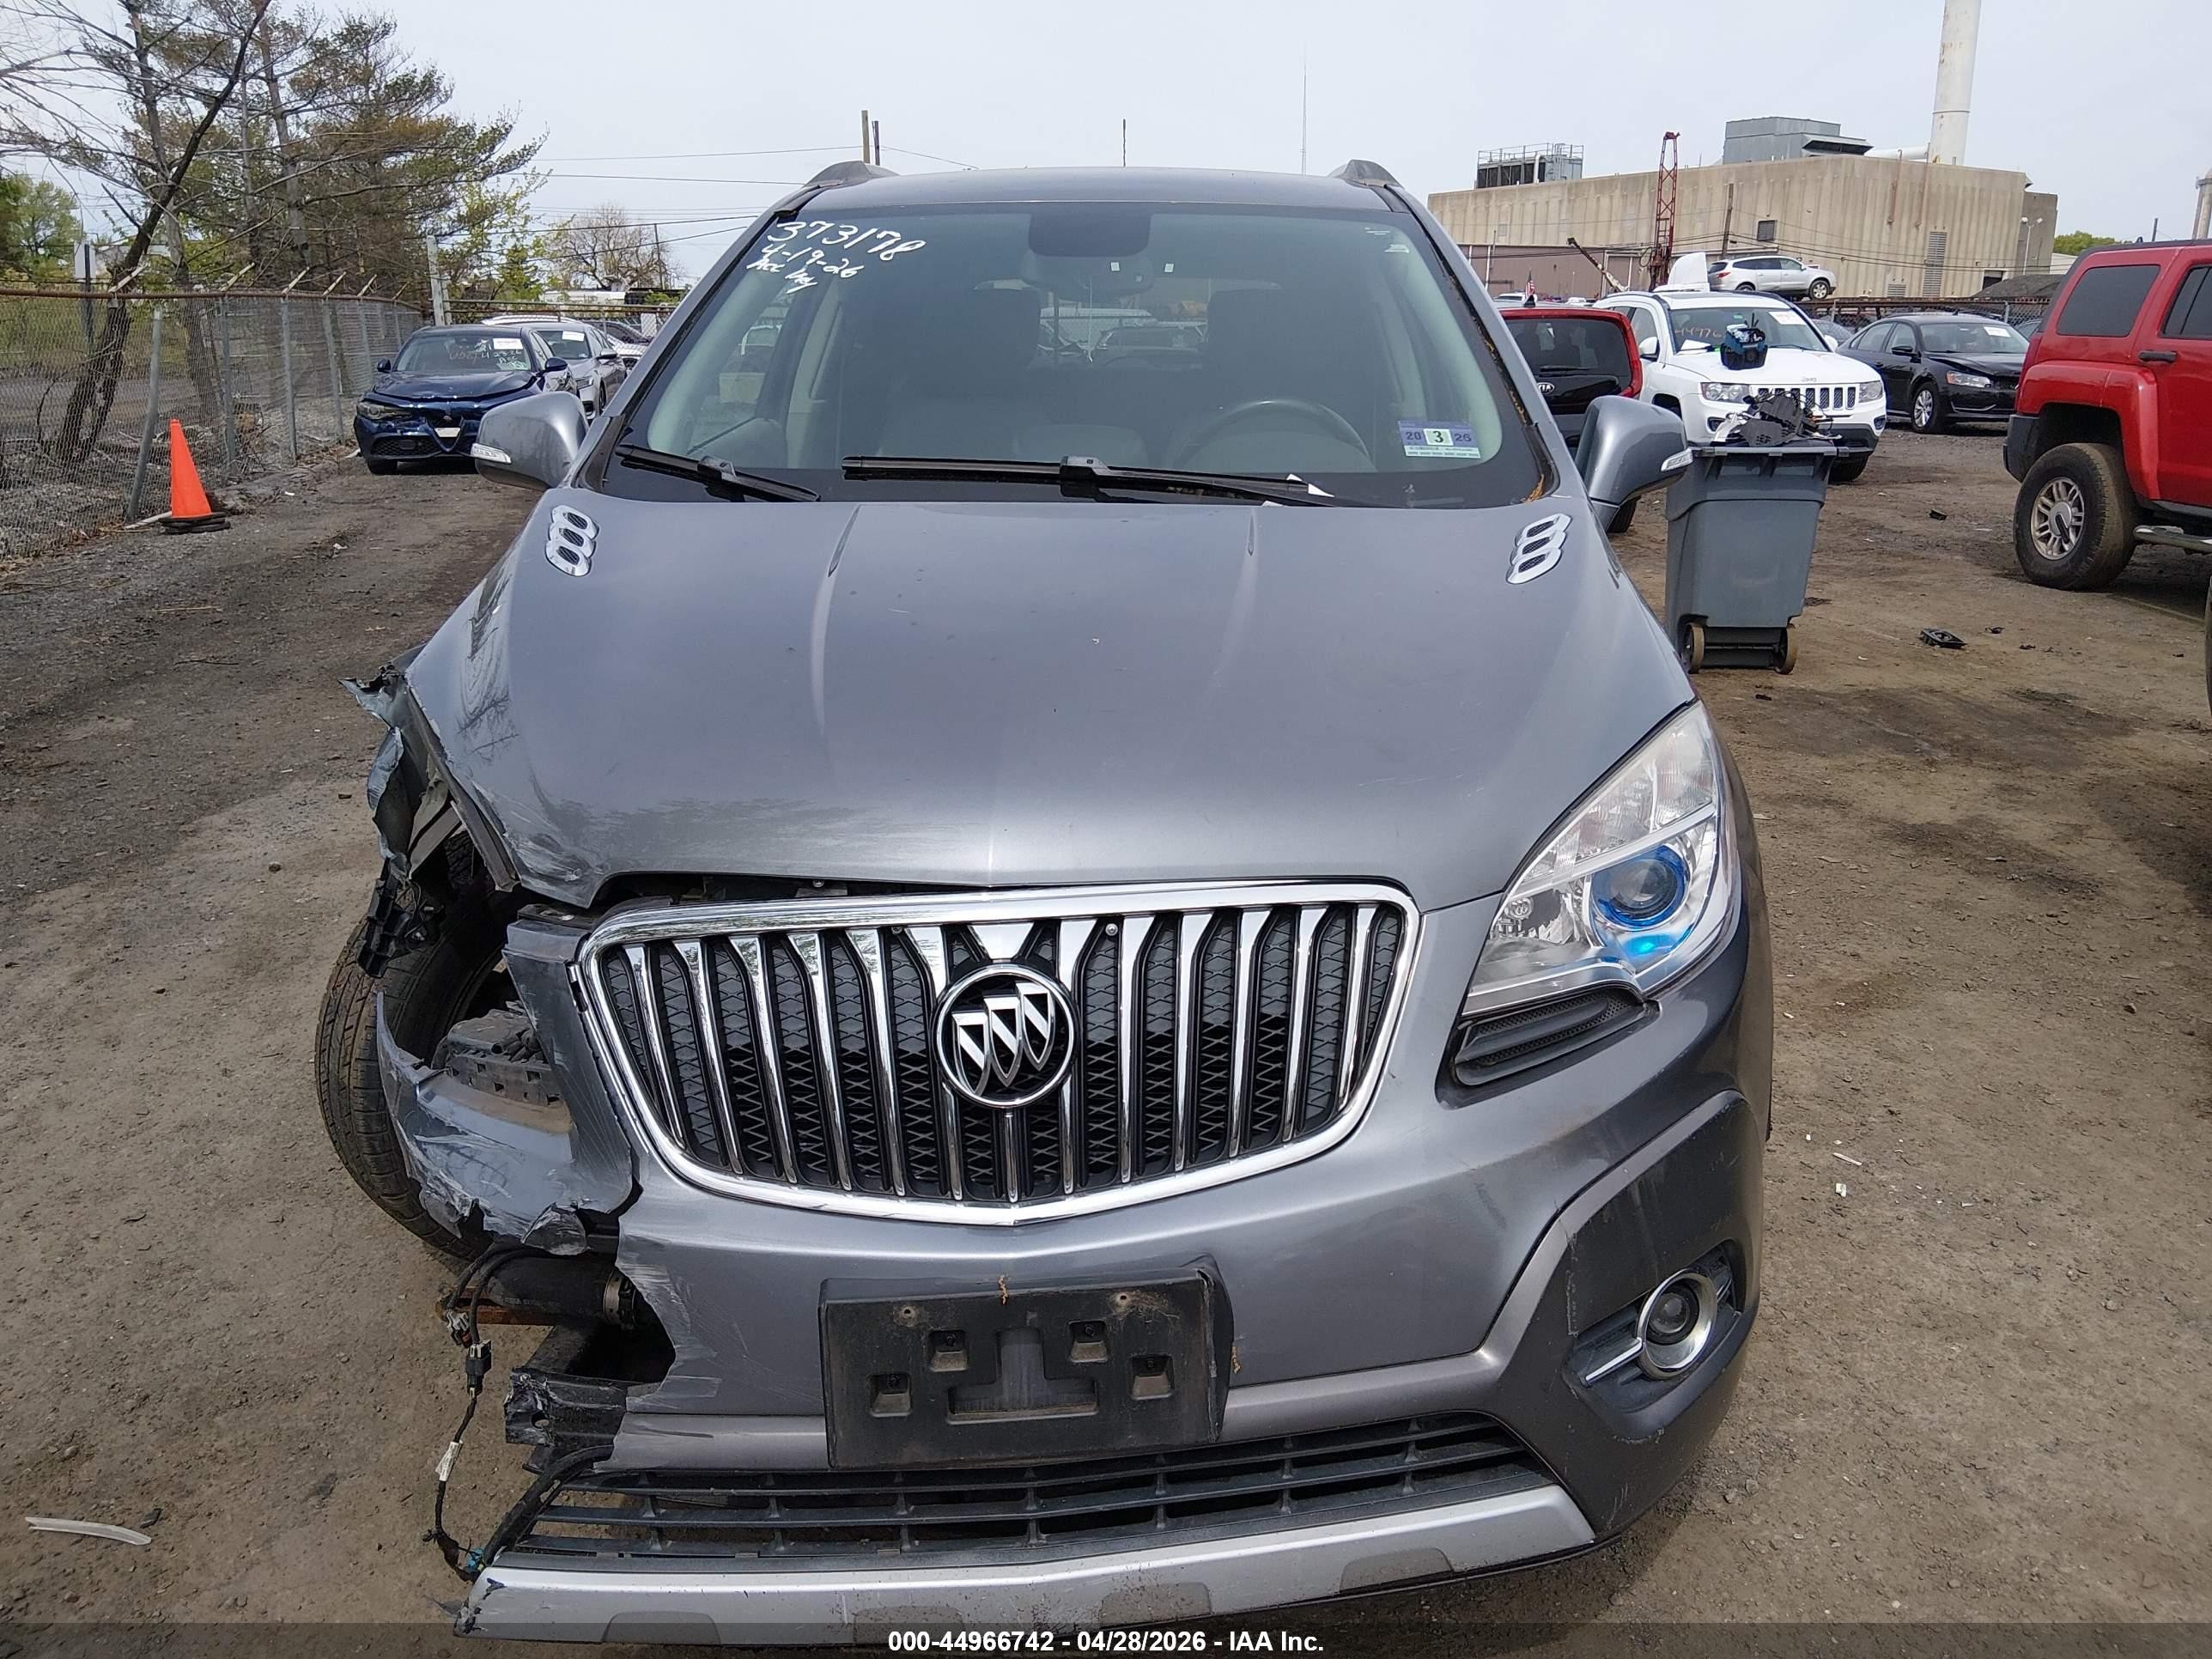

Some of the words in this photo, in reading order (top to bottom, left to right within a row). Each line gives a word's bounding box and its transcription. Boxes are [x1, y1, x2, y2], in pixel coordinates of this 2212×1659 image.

[768, 220, 927, 261] 373178
[1405, 431, 1422, 441] 20
[1432, 430, 1444, 443] 3
